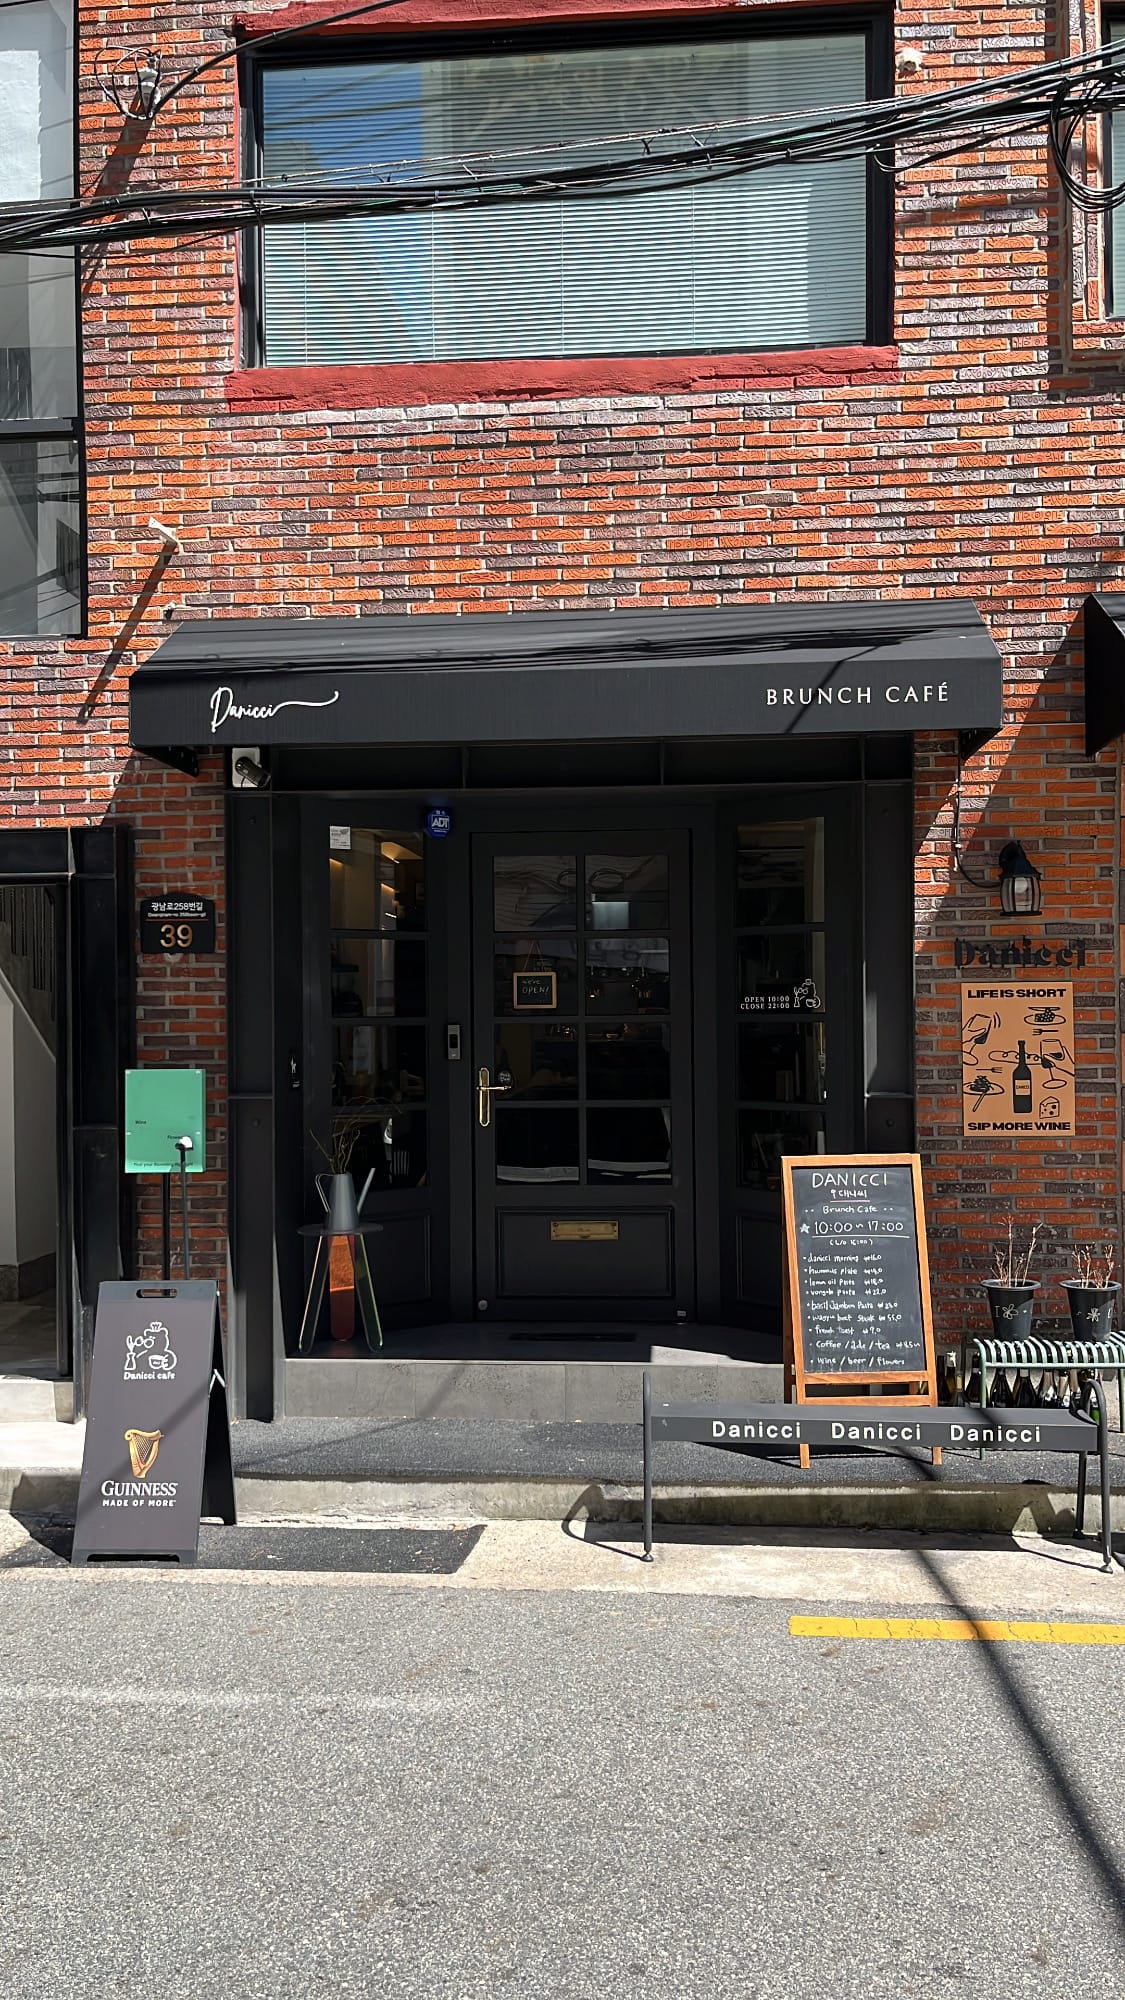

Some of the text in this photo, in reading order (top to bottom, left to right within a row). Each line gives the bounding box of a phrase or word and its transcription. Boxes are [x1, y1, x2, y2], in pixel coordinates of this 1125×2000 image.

[766, 681, 949, 705] BRUNCH CAFÉ
[210, 686, 339, 732] Danicci
[431, 817, 450, 829] ADT
[151, 902, 203, 911] 광남로258번길
[160, 924, 193, 948] 39
[954, 935, 1086, 970] Danicci
[768, 995, 790, 1003] 10:00
[967, 988, 1066, 998] LIFE IS SHORT
[967, 1121, 1071, 1131] SIP MORE WINE
[812, 1172, 888, 1188] DANICCI
[822, 1205, 879, 1214] Brunch Cafe
[814, 1221, 853, 1234] 10:00
[867, 1220, 904, 1232] 17:00
[123, 1371, 176, 1380] Danicci cafe
[712, 1420, 1041, 1443] Danicci Danicci Danicci
[101, 1480, 177, 1496] GUINNESS
[102, 1499, 175, 1507] MADE OF MORE
